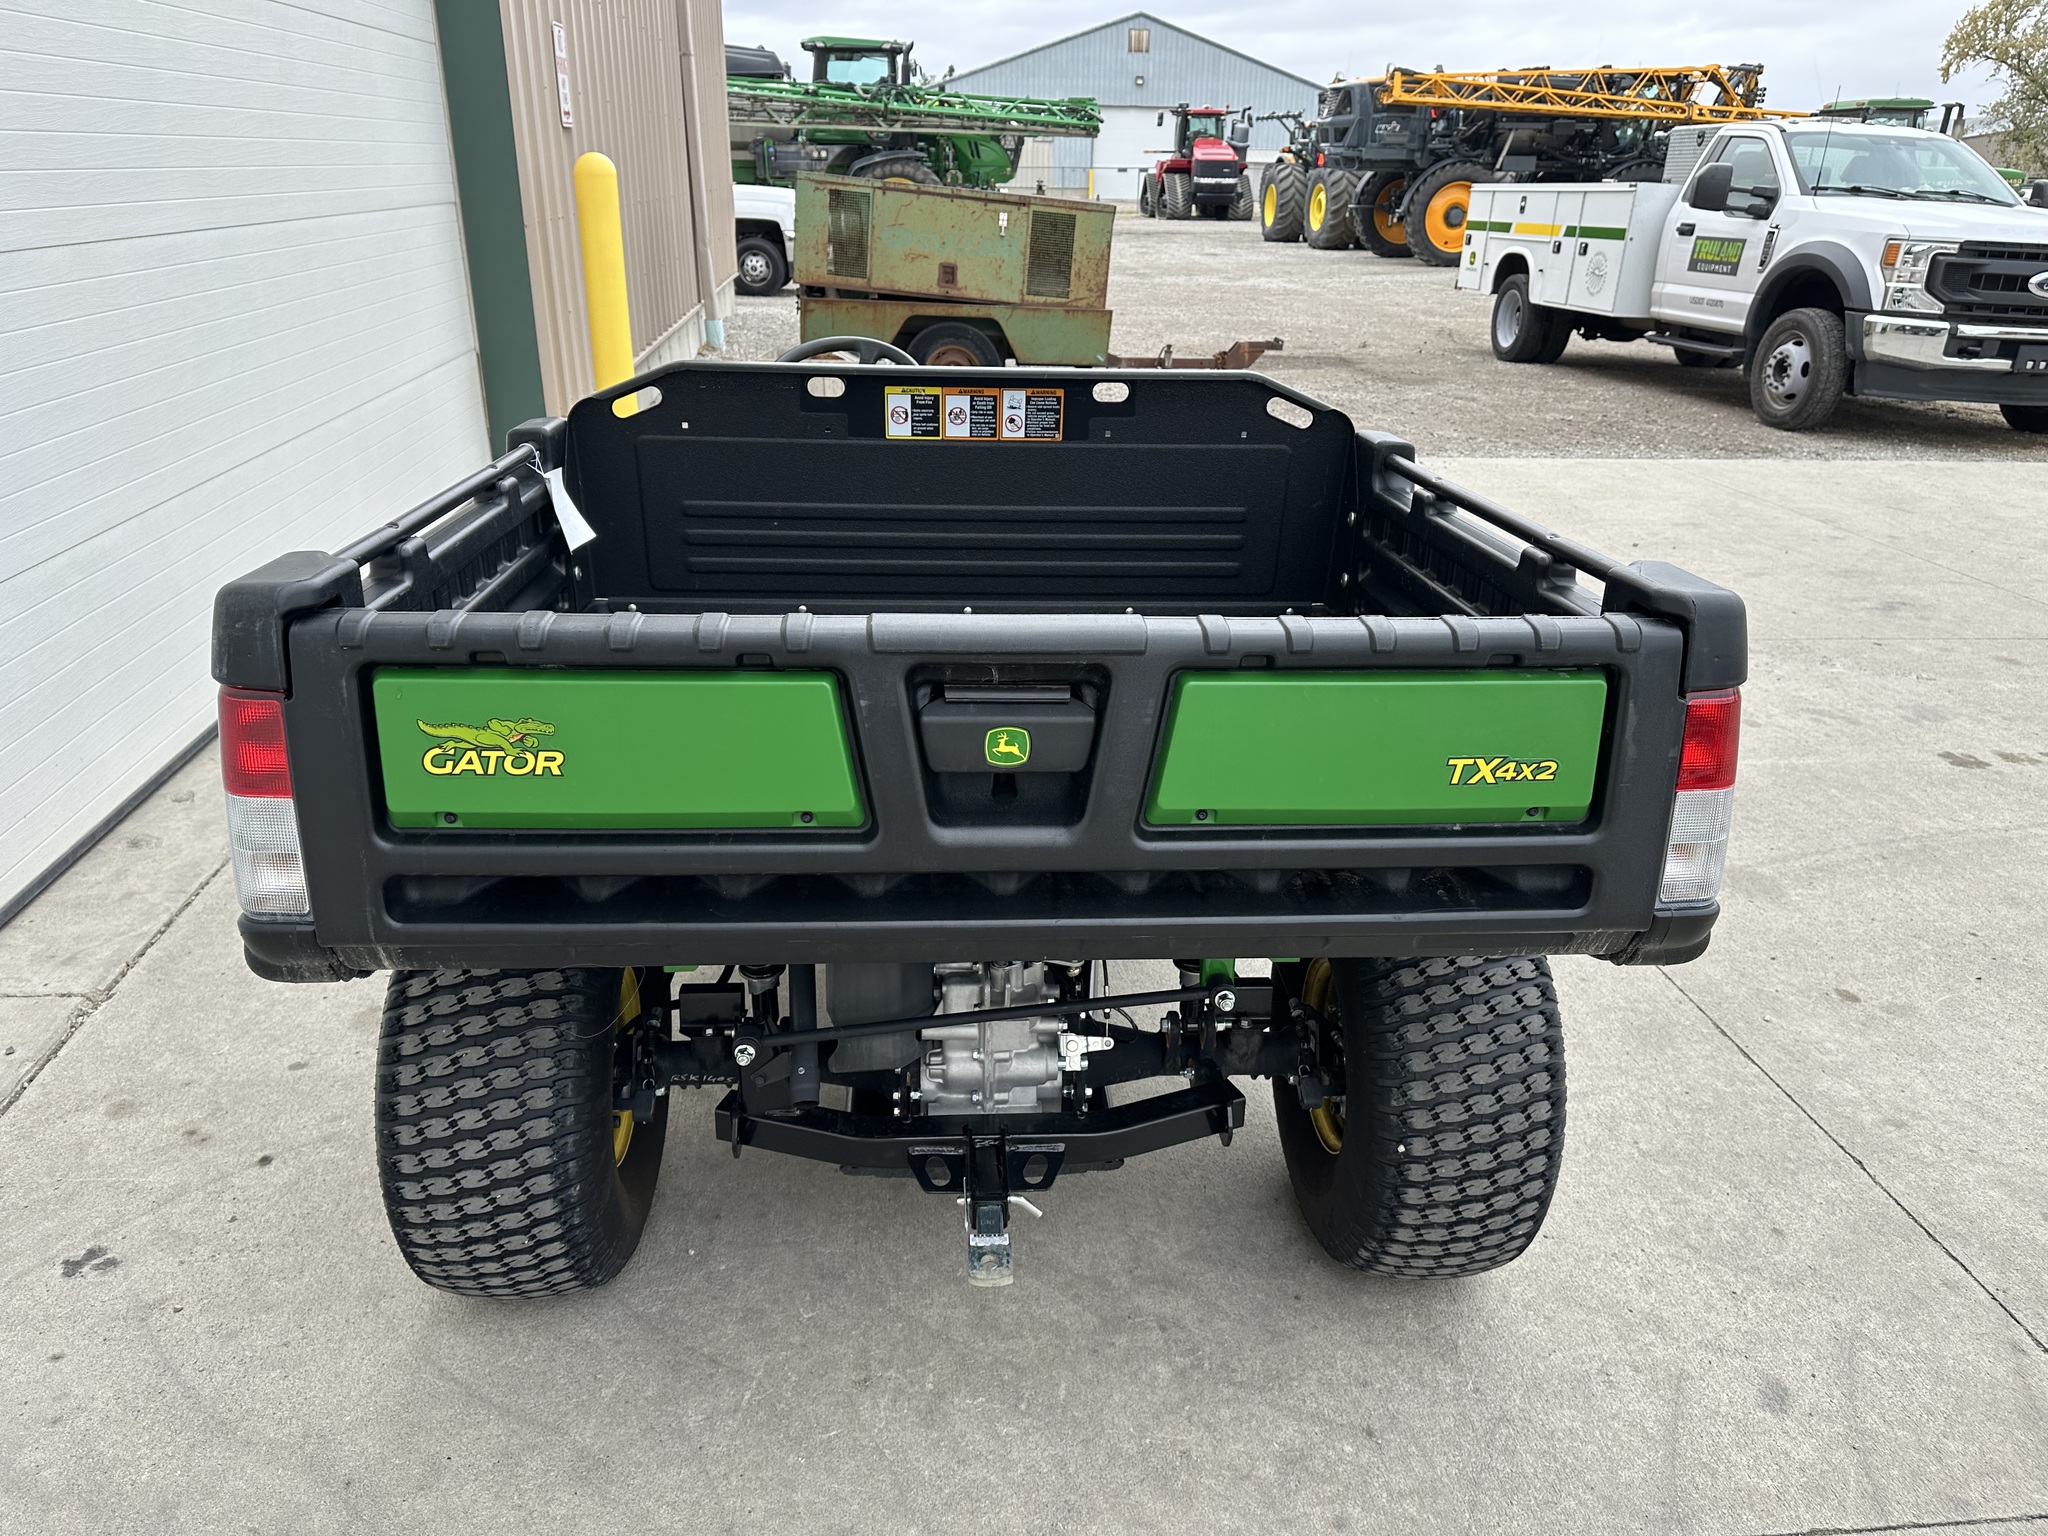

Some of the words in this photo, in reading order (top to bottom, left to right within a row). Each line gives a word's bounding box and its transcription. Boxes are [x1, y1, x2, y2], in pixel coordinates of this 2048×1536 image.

[1692, 239, 1744, 263] TRULAND
[1696, 262, 1732, 274] EQUIPMENT
[422, 747, 565, 776] GATOR
